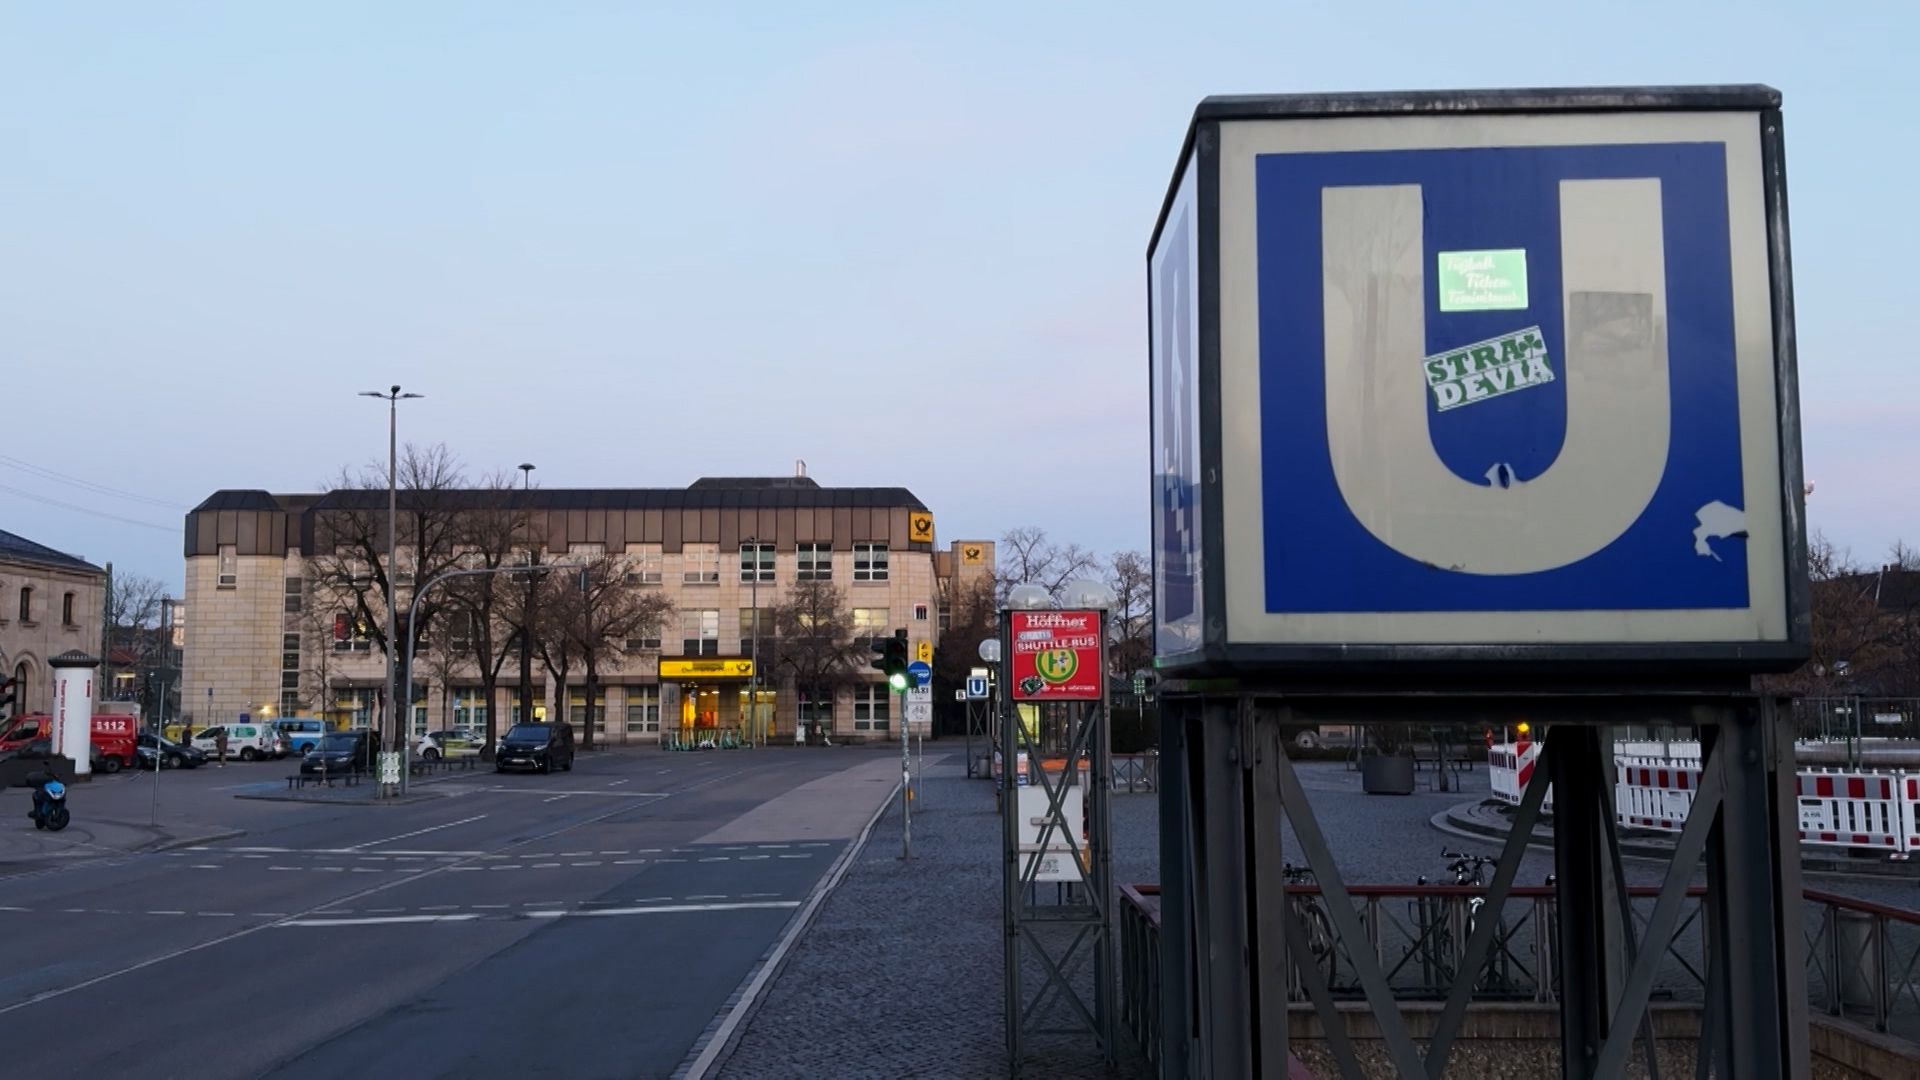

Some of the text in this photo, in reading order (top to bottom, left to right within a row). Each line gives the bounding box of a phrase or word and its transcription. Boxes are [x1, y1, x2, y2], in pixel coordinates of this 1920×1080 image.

[1427, 339, 1525, 382] STRA
[1322, 178, 1671, 575] U
[1433, 357, 1553, 407] DEVIA
[1026, 613, 1087, 628] Höffner
[971, 680, 984, 695] U
[103, 721, 126, 730] 112
